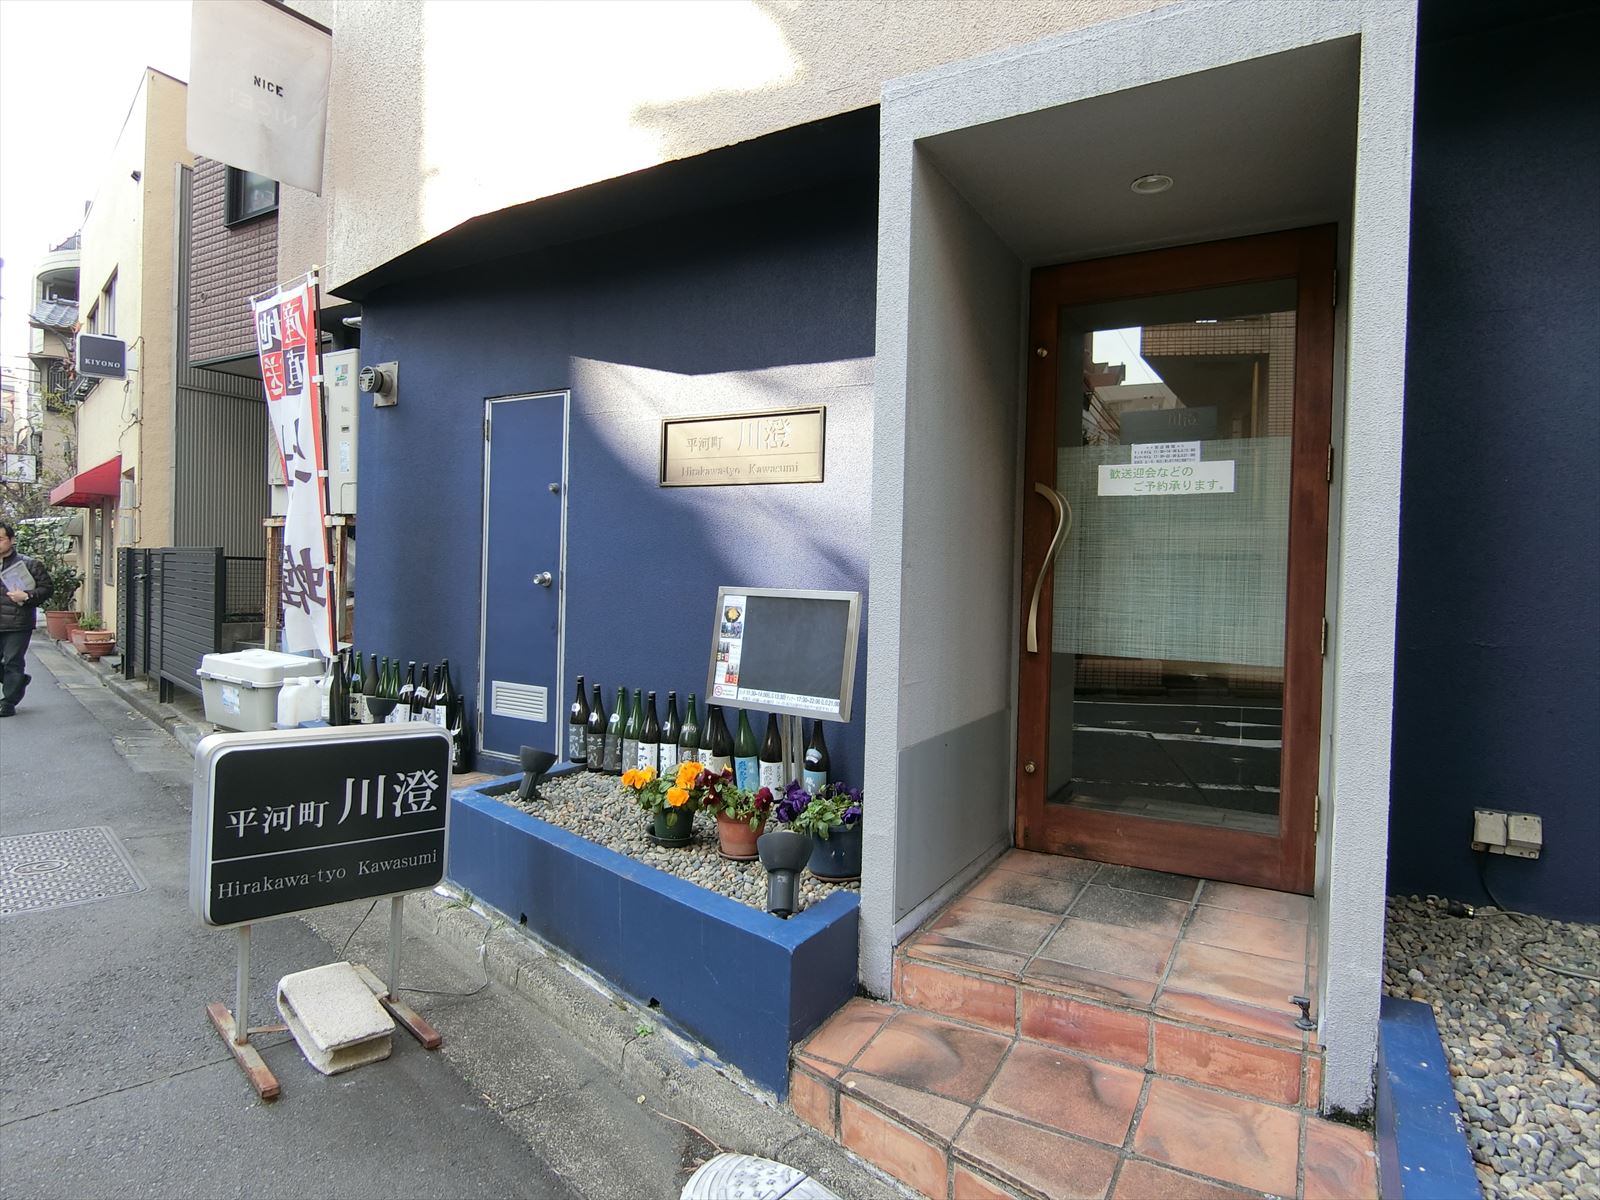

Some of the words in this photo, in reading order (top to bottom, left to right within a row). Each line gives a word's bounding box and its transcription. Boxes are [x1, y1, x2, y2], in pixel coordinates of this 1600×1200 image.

[253, 75, 284, 98] NICE
[84, 357, 121, 369] KIYONO
[686, 435, 724, 453] 平河町
[737, 417, 792, 451] 川澄
[1109, 465, 1194, 480] 歓送迎会などの
[1133, 479, 1224, 492] ご予約承ります。
[225, 800, 330, 838] 平河町
[337, 769, 440, 825] 川澄
[216, 866, 347, 900] Hirakawa-tyo
[357, 848, 438, 876] Kawasumi
